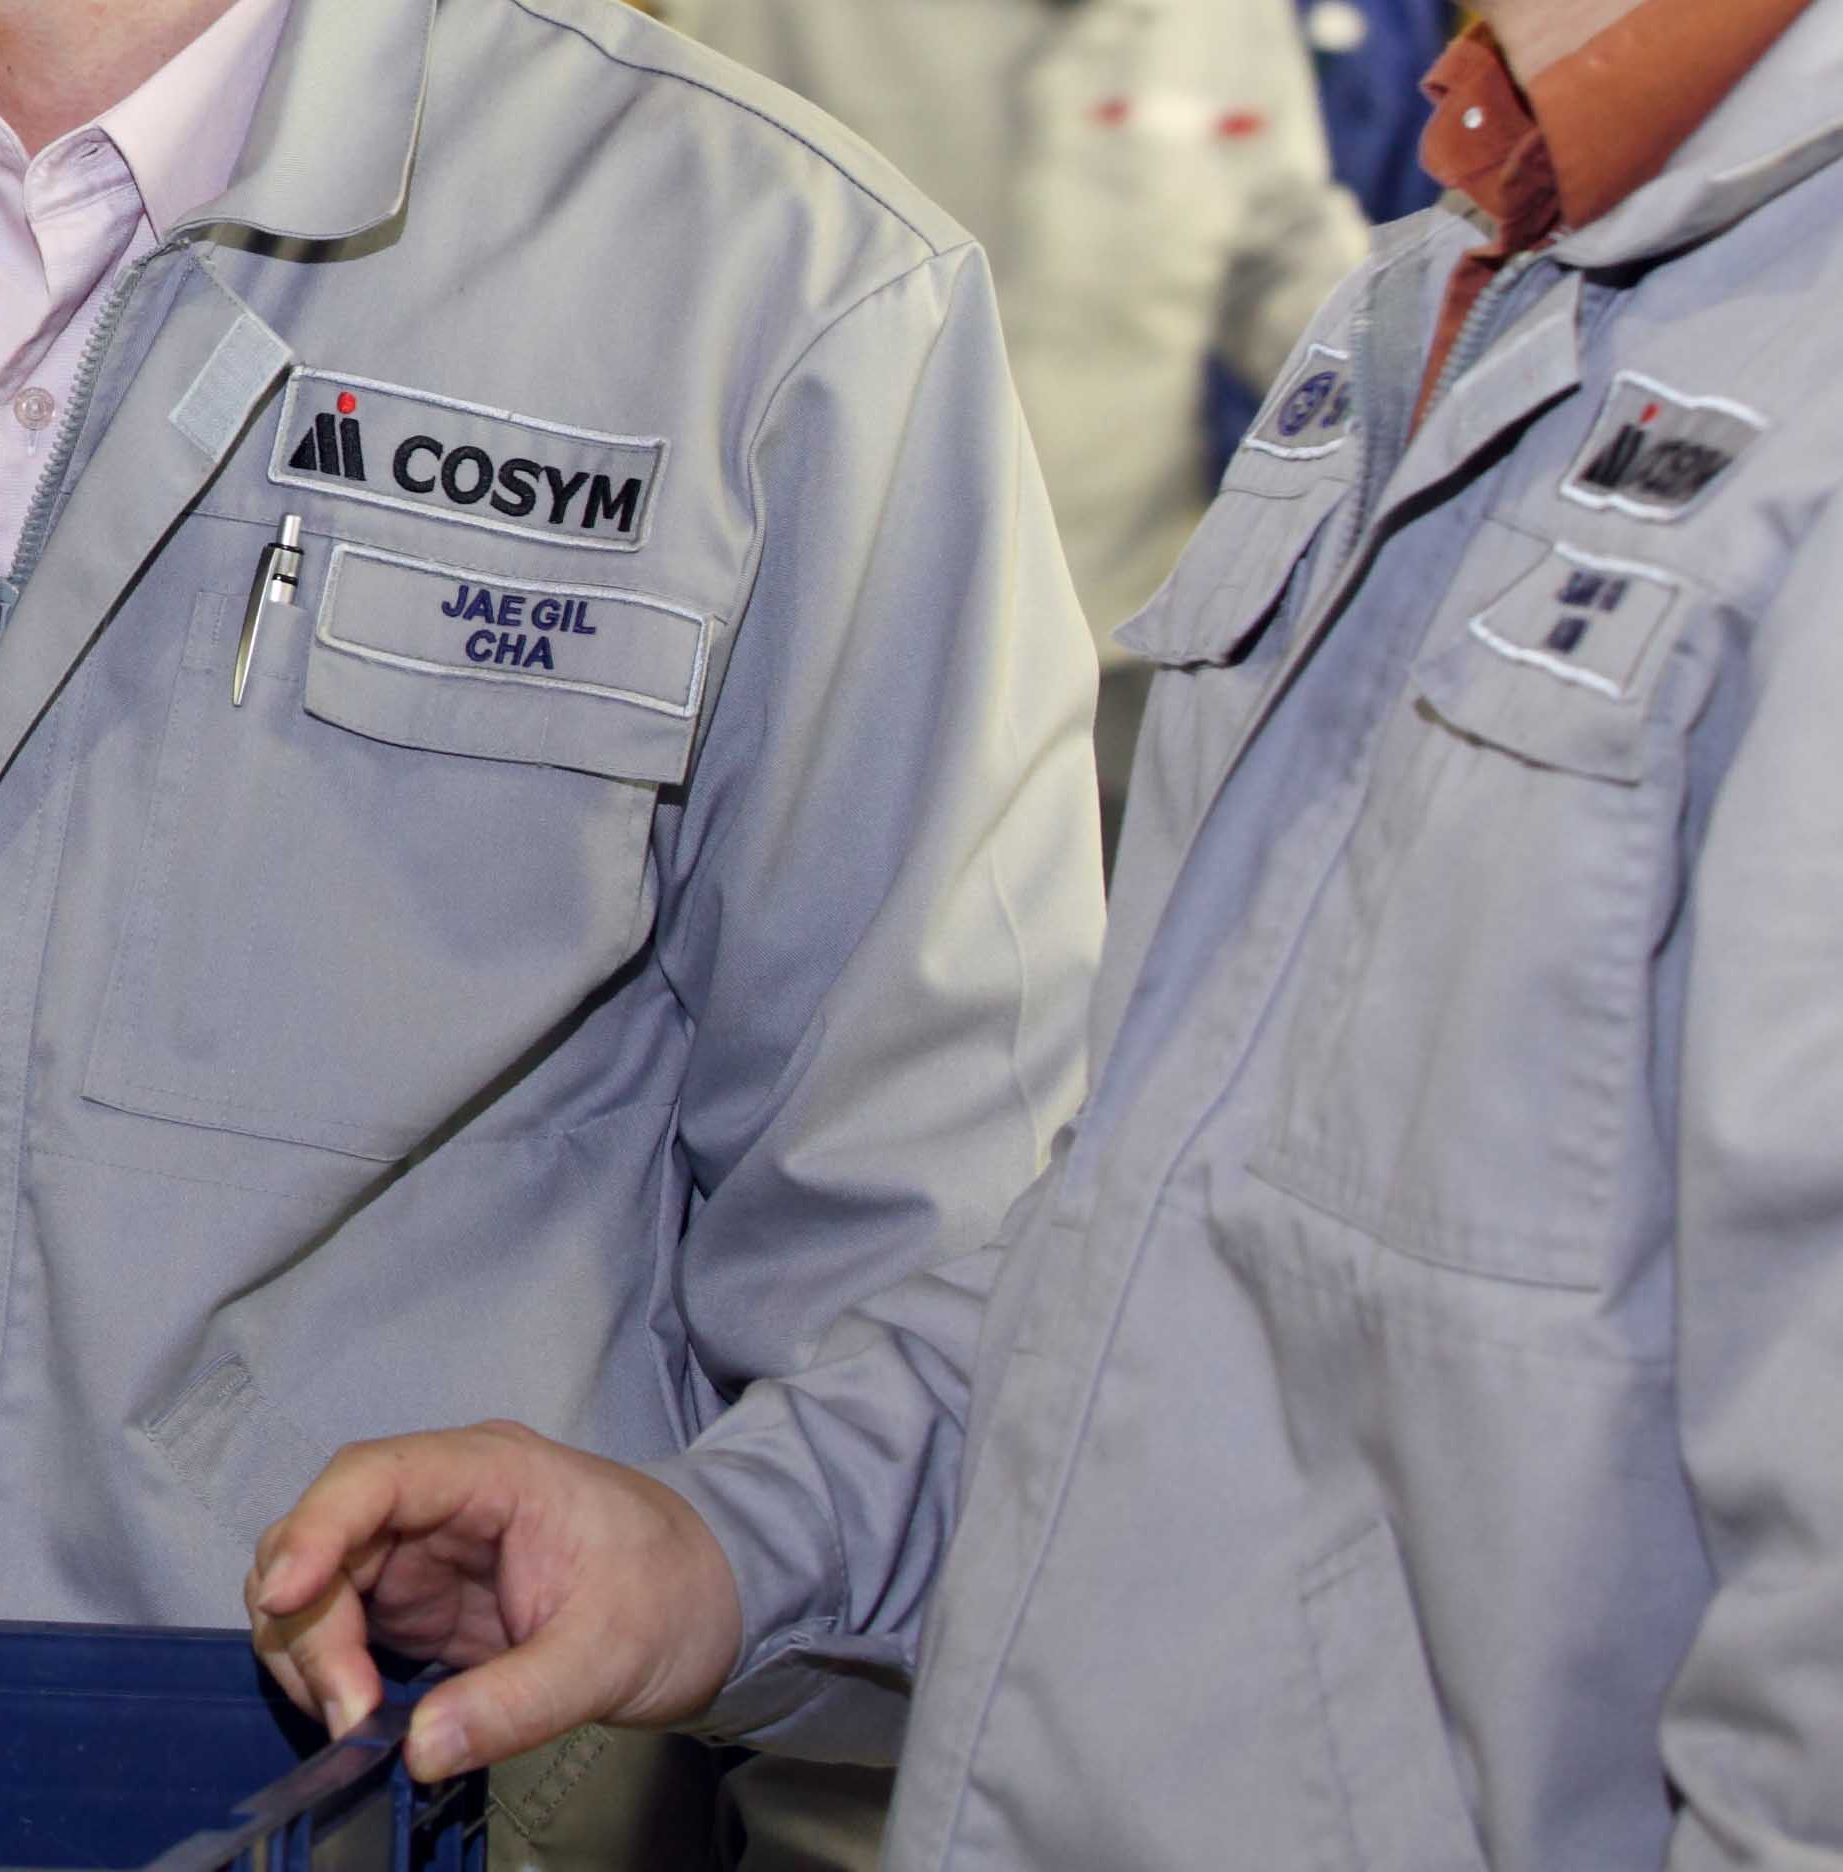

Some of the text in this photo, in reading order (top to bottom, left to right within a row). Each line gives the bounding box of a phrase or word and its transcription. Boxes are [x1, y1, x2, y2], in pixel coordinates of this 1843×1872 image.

[392, 435, 642, 532] COSYM
[441, 585, 597, 635] JAE GIL
[465, 629, 555, 670] CHA
